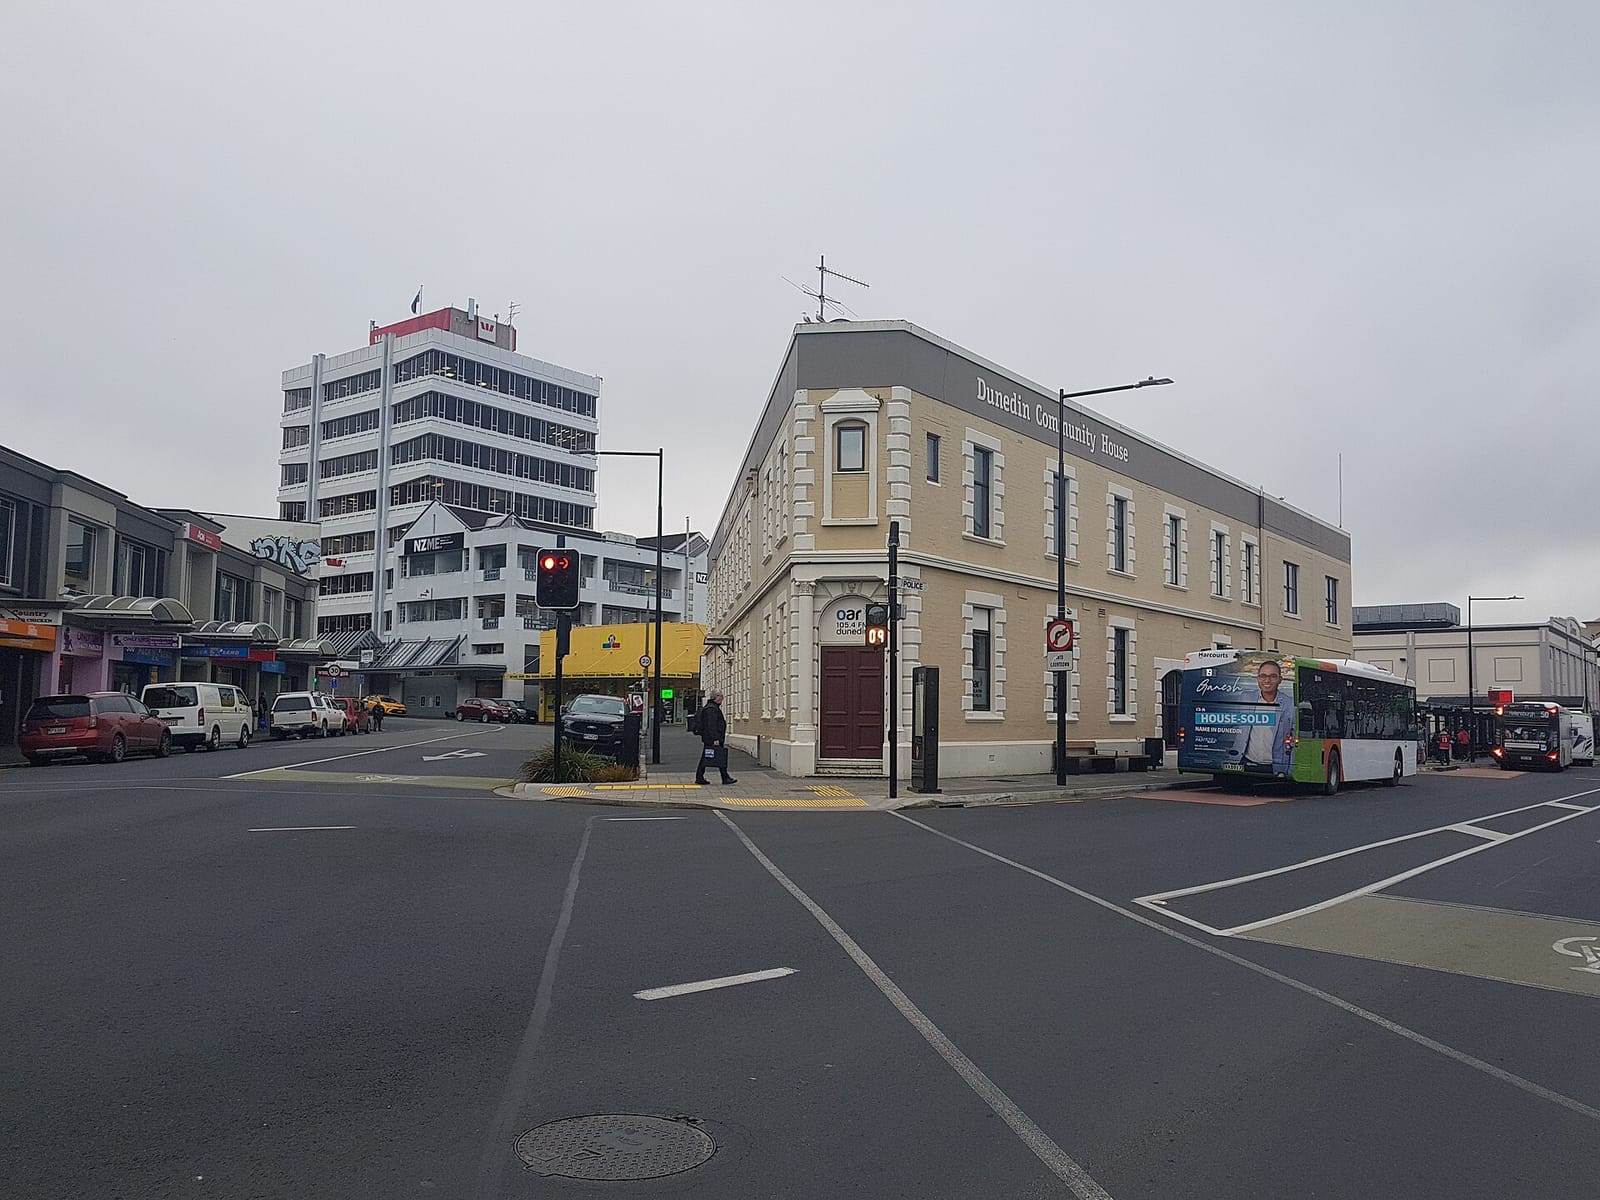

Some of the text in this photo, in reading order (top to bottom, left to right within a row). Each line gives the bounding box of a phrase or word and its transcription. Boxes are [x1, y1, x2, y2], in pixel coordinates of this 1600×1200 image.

[976, 377, 1031, 420] Dunedin
[1101, 433, 1129, 462] House
[903, 580, 923, 590] POLICE
[836, 609, 862, 621] oar
[836, 621, 856, 629] 105.4
[869, 629, 884, 644] 09
[1196, 677, 1242, 696] Ganesh
[1201, 714, 1269, 724] HOUSE-SOLD
